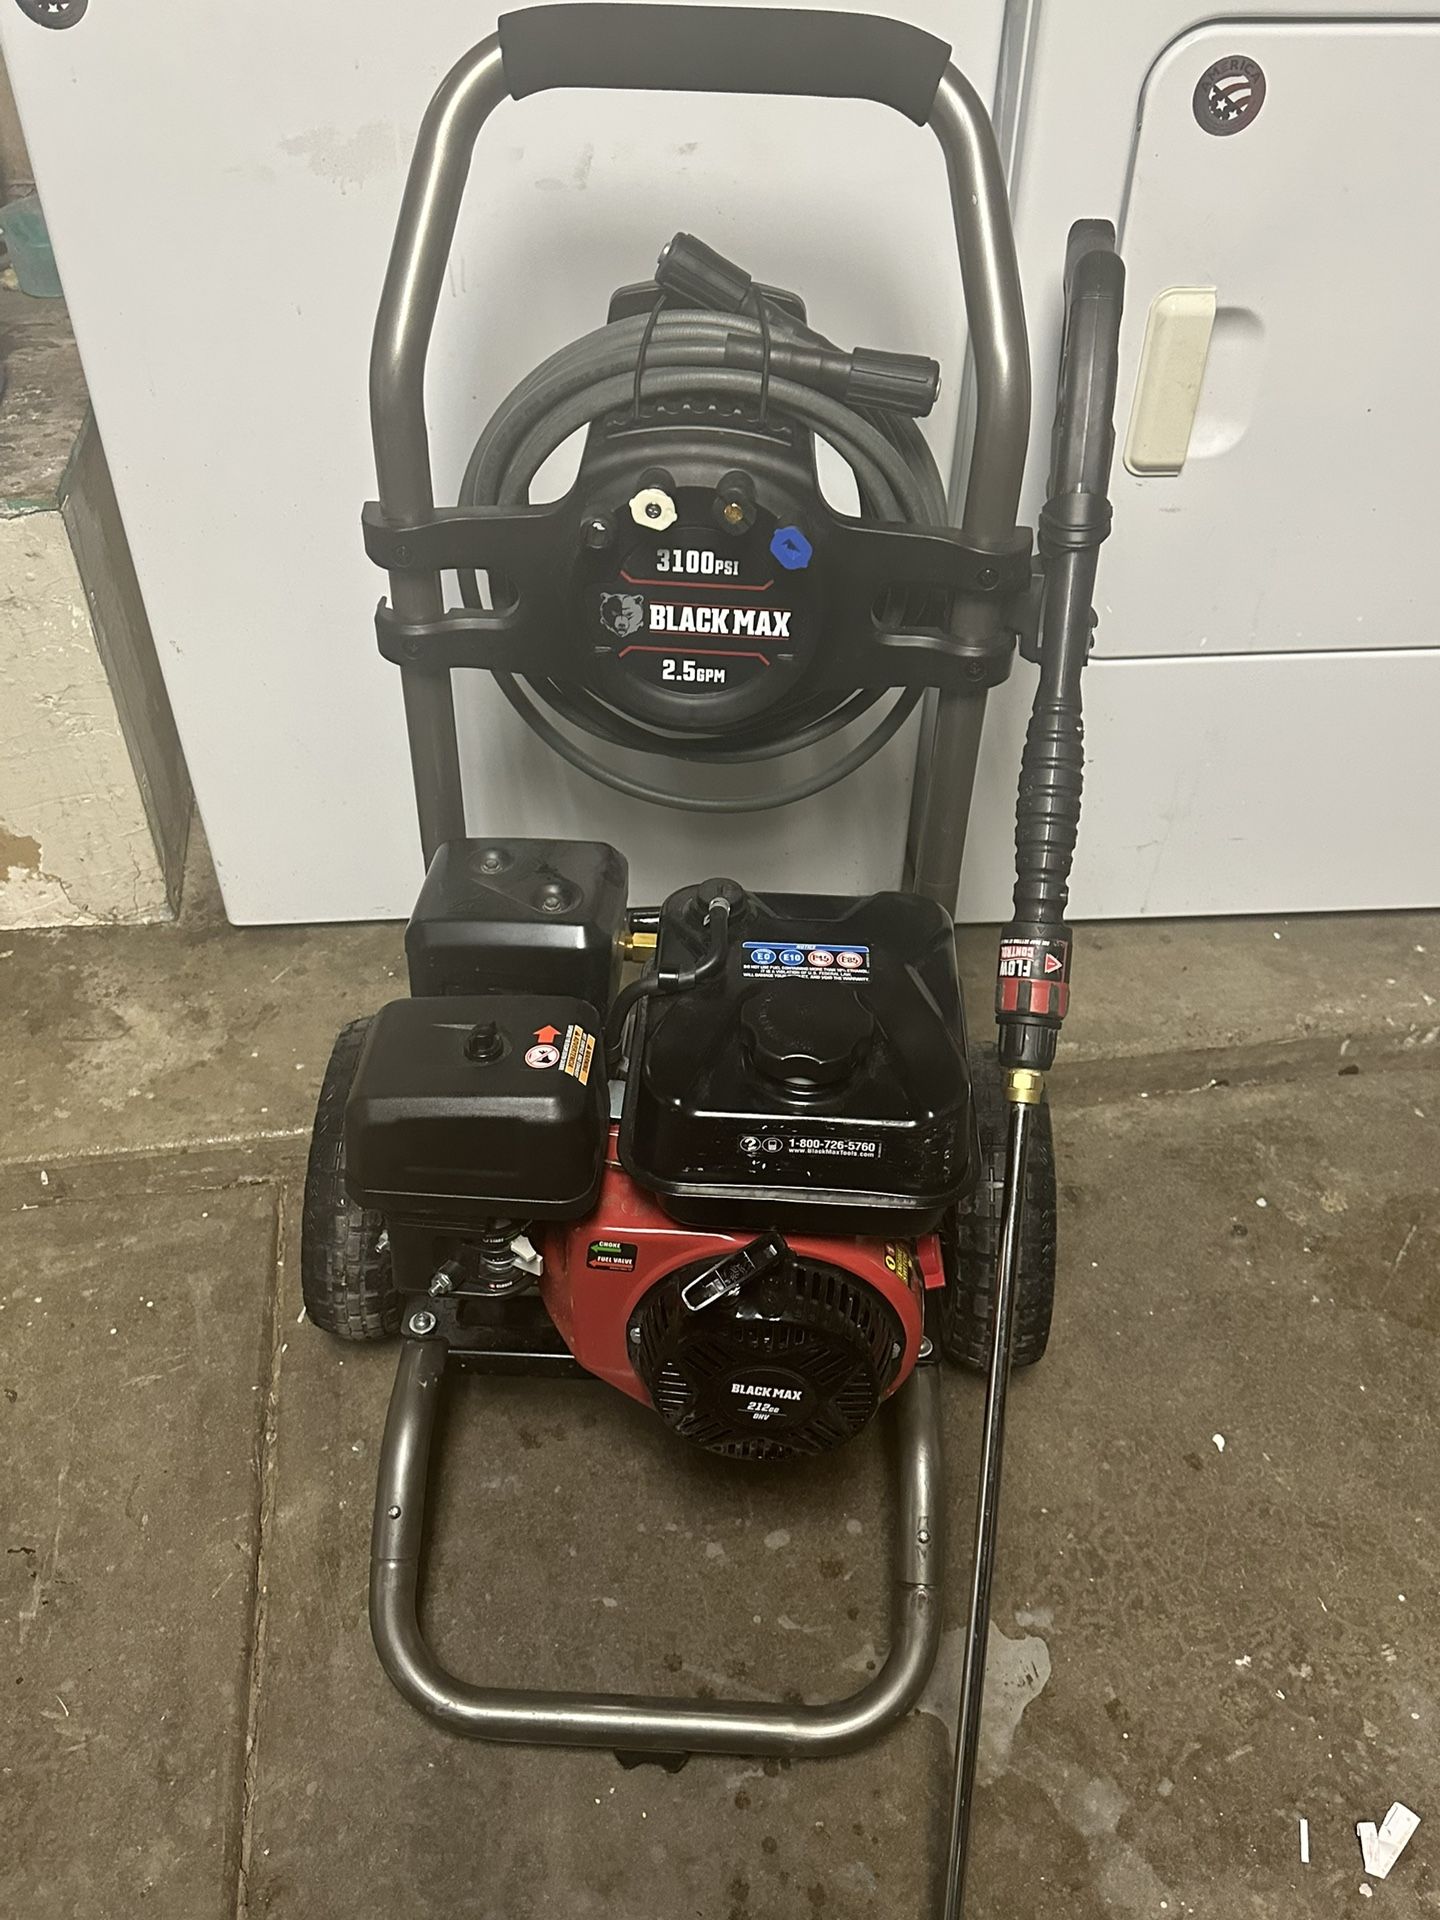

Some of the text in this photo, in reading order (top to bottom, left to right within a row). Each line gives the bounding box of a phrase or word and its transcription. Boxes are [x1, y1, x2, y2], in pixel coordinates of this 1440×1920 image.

[1201, 59, 1261, 93] AMERICA
[649, 604, 791, 638] BLACK MAX
[1001, 946, 1035, 958] CONTRO
[999, 960, 1031, 977] FLOW
[788, 1138, 876, 1152] 1-800-726-5760
[788, 1148, 875, 1157] www.BlackMaxTools.com
[598, 1241, 621, 1249] CHOKE
[597, 1255, 633, 1265] FUEL VALVE
[731, 1383, 803, 1401] BLACK MAX
